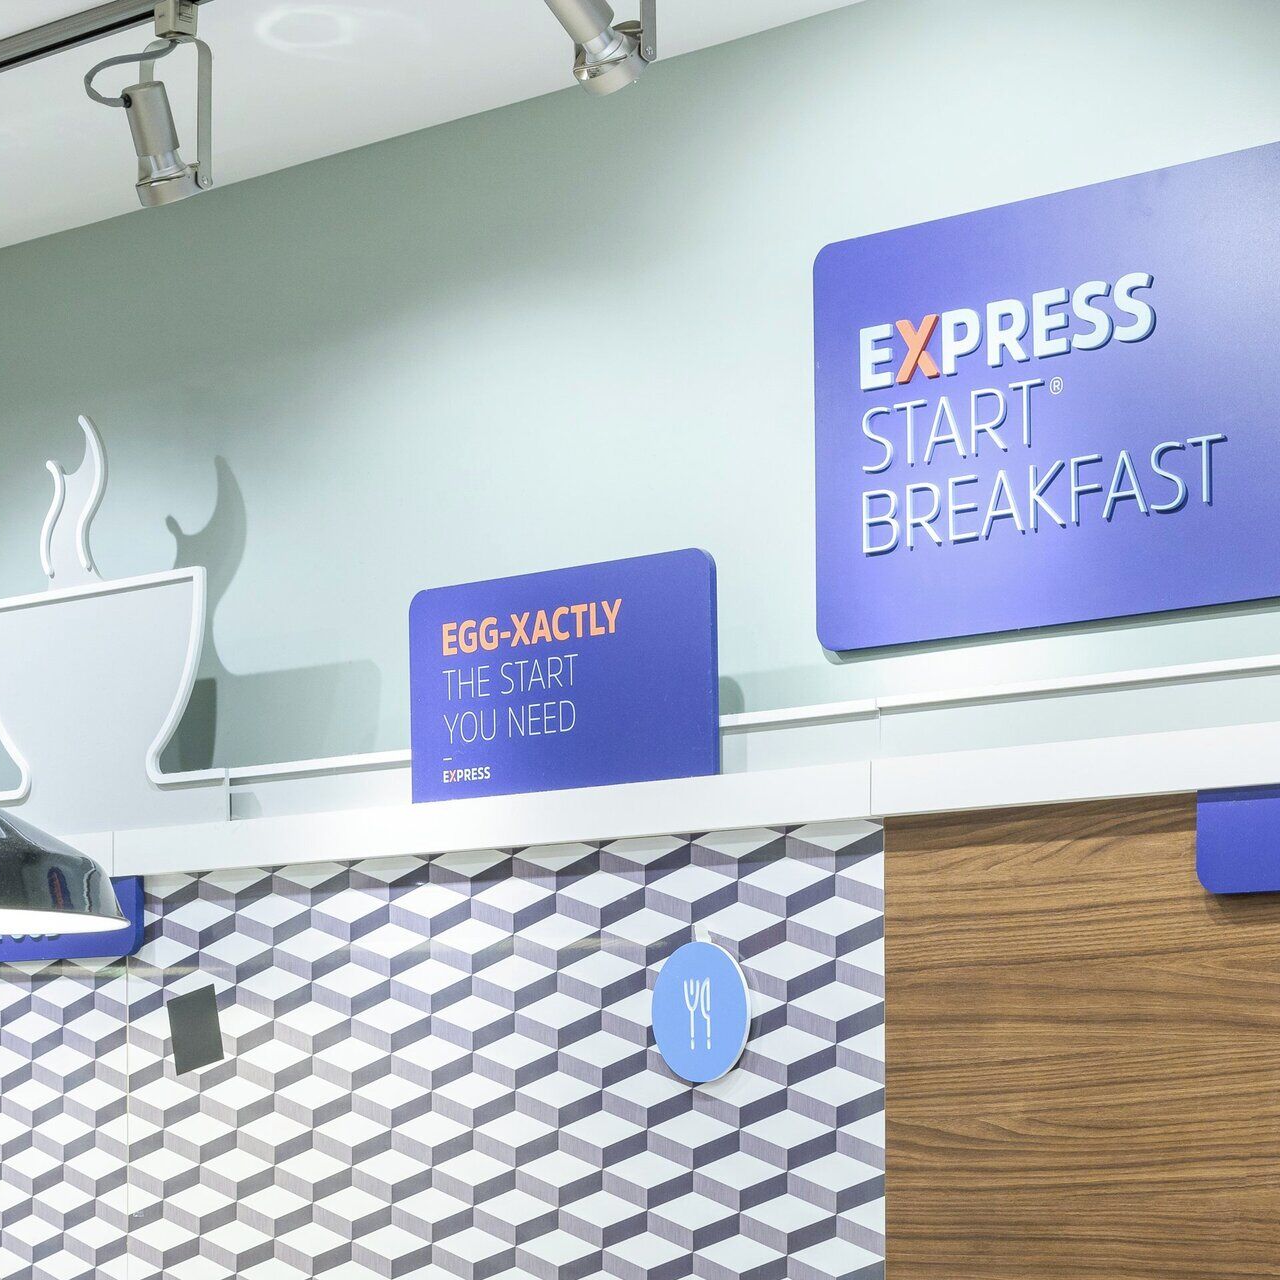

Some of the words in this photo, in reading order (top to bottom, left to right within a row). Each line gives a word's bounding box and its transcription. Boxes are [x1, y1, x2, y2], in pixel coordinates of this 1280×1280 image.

[859, 272, 1157, 392] EXPRESS
[862, 433, 1228, 557] BREAKFAST
[441, 598, 623, 657] EGG-XACTLY
[442, 665, 491, 701] THE
[500, 653, 579, 695] START
[442, 708, 497, 745] YOU
[508, 700, 577, 738] NEED
[442, 766, 491, 784] EXPRESS
